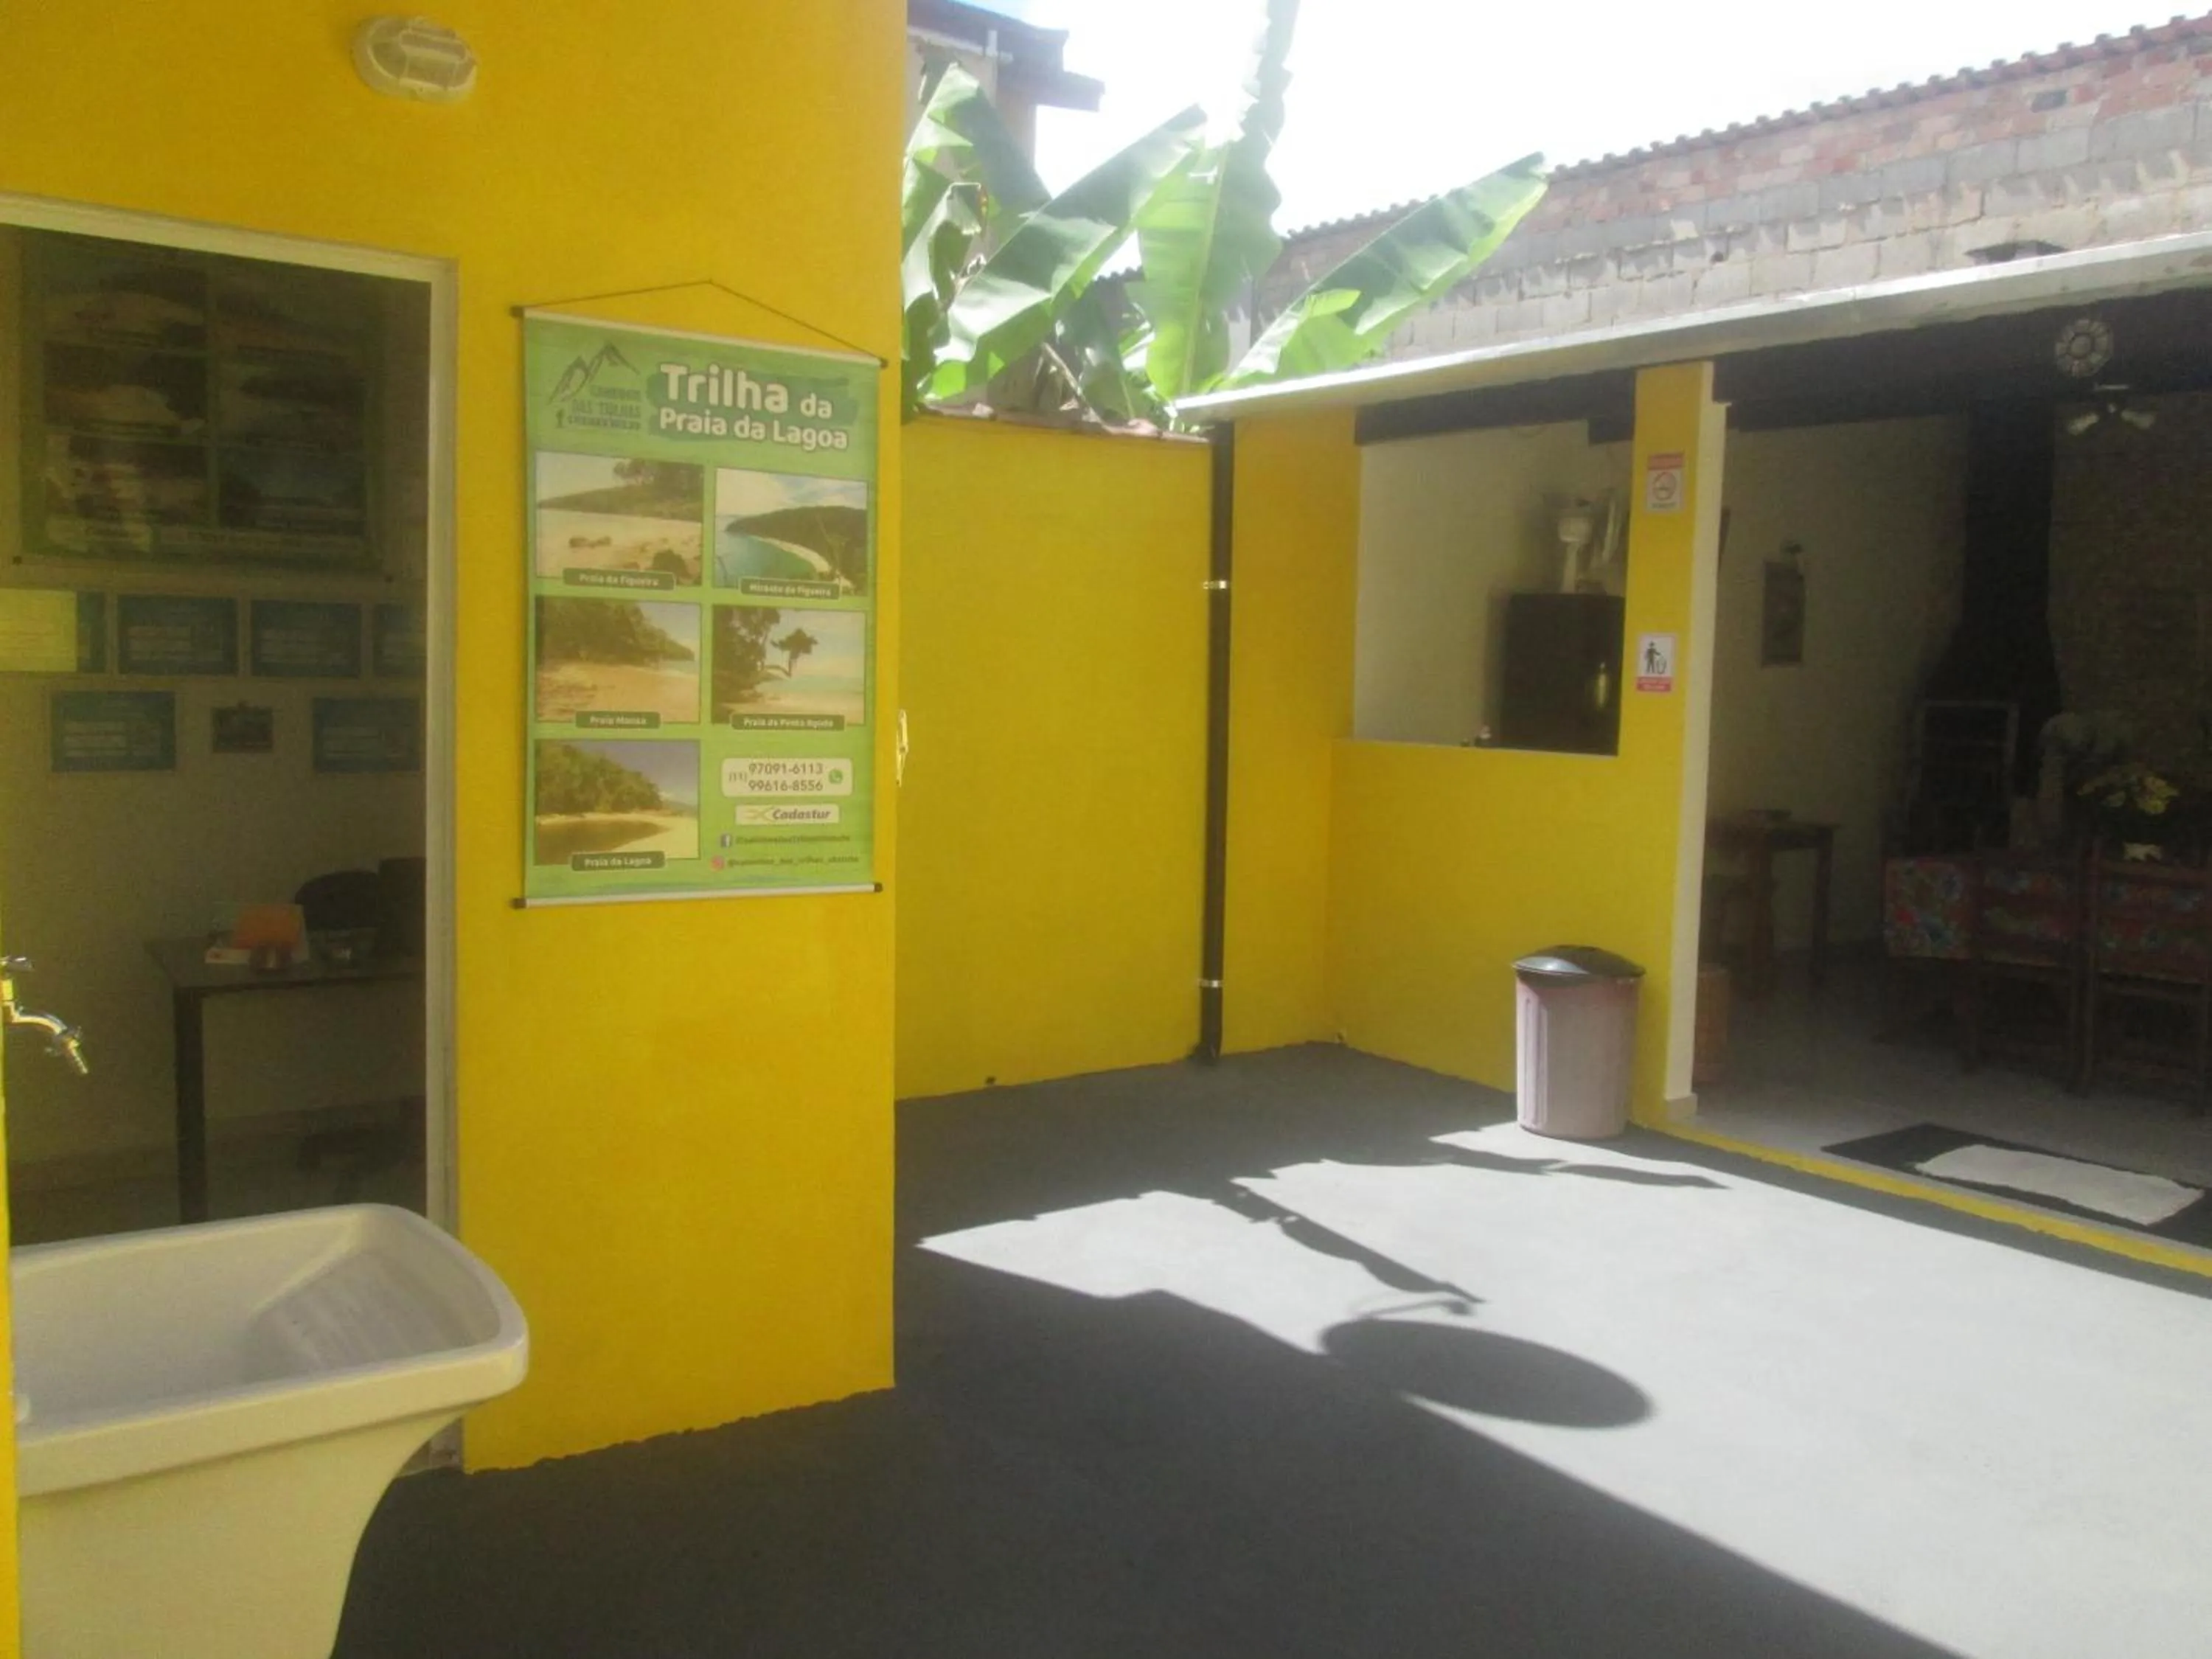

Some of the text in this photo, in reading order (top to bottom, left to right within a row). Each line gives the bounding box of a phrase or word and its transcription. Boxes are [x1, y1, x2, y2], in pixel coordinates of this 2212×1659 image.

[660, 363, 789, 414] Trilha
[800, 392, 832, 419] da
[660, 407, 727, 436] Praia
[734, 414, 765, 440] da
[773, 420, 848, 451] Lagoa
[579, 573, 604, 583] Praia
[748, 762, 824, 775] 97091-6113
[748, 779, 824, 792] 99616-8556
[772, 807, 832, 821] Cadastur
[584, 858, 608, 868] Praia
